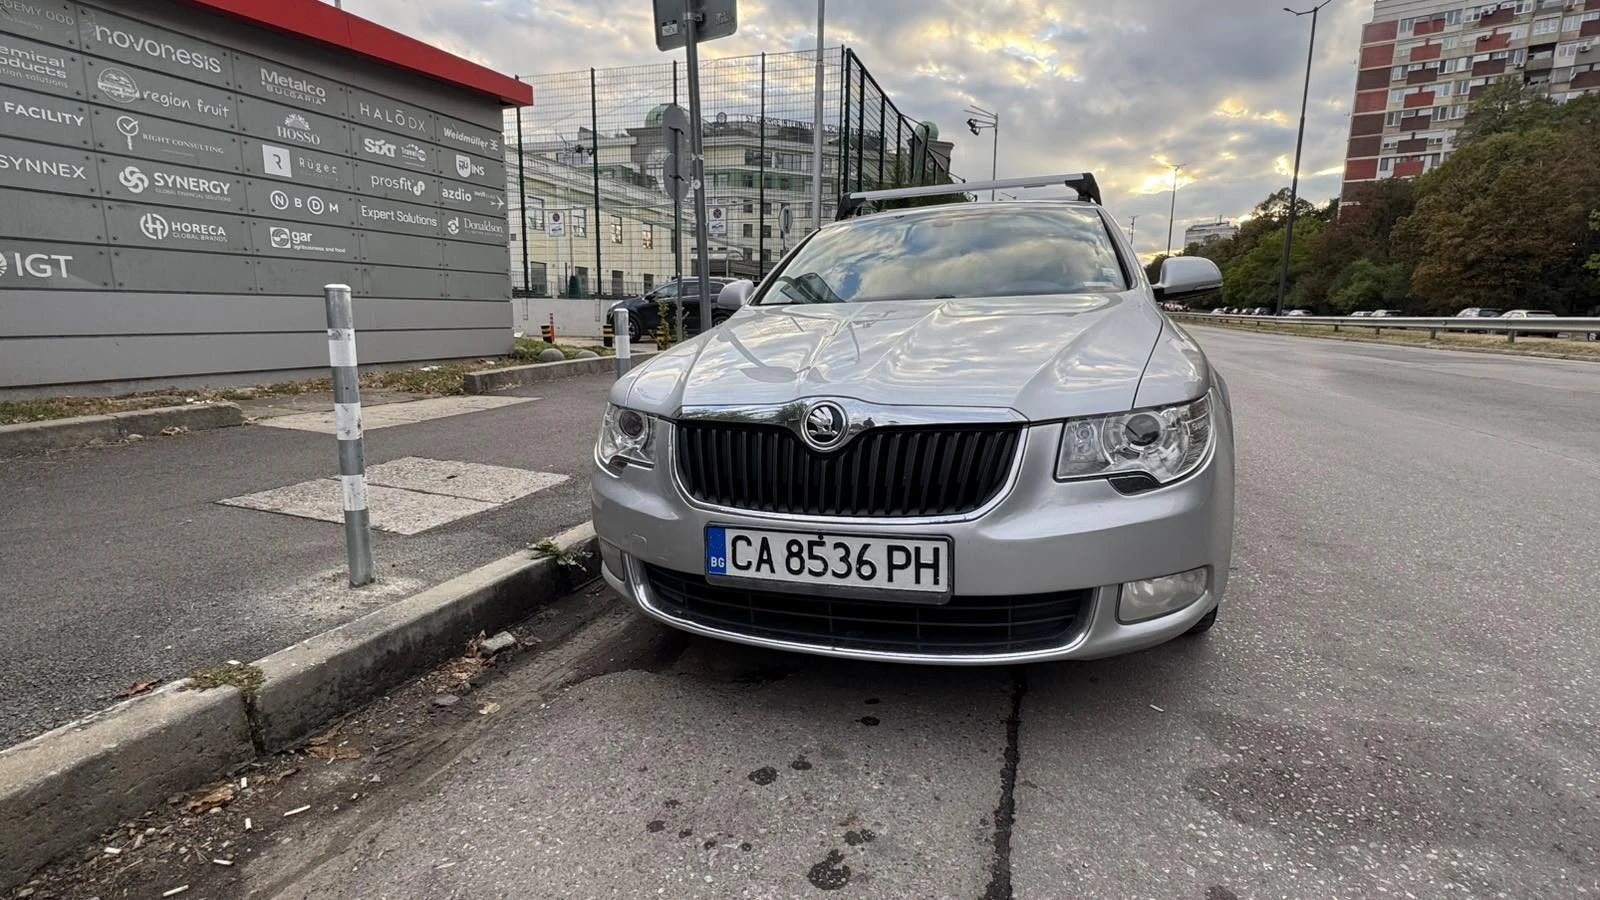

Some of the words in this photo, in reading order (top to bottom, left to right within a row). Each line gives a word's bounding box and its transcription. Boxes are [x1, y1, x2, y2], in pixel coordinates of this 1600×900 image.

[0, 46, 65, 68] emical
[95, 25, 221, 73] novonesis
[261, 68, 326, 97] Metalco
[4, 101, 84, 127] FACILITY
[143, 90, 190, 108] region
[197, 98, 230, 119] fruit
[142, 133, 170, 144] RIGHT
[171, 139, 224, 154] CONSULTING
[277, 126, 321, 145] HOSSO
[443, 127, 489, 148] Weidmüller
[0, 154, 87, 181] SYNNEX
[153, 172, 230, 195] SYNERGY
[371, 175, 412, 191] prosfit
[442, 187, 472, 202] azdio
[361, 205, 395, 221] Expert
[396, 211, 438, 227] Solutions
[464, 218, 503, 233] Donaldson
[171, 221, 226, 236] HORECA
[200, 234, 228, 243] BRANDS
[291, 231, 313, 244] gar
[14, 252, 73, 279] IGT
[711, 556, 725, 568] BG
[731, 535, 775, 574] CA
[785, 539, 877, 581] 8536
[887, 544, 940, 585] PH
